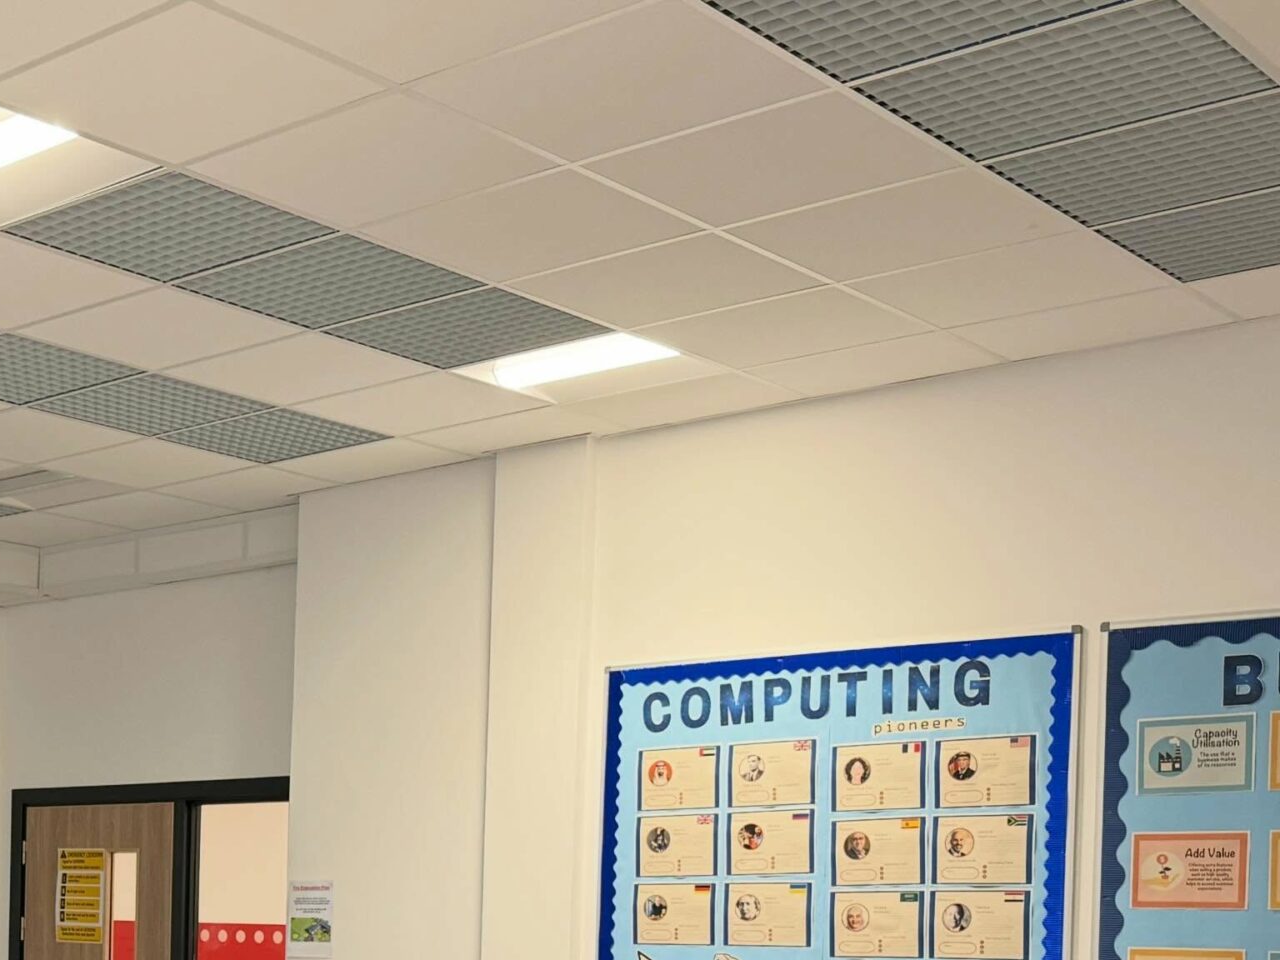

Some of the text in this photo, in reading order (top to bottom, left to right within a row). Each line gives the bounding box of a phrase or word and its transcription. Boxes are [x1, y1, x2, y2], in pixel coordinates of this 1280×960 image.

[642, 659, 992, 733] COMPUTING
[874, 717, 966, 735] pioneers
[1194, 728, 1238, 740] Capacity
[1192, 738, 1240, 748] Utilisation
[1185, 847, 1236, 858] Add Value
